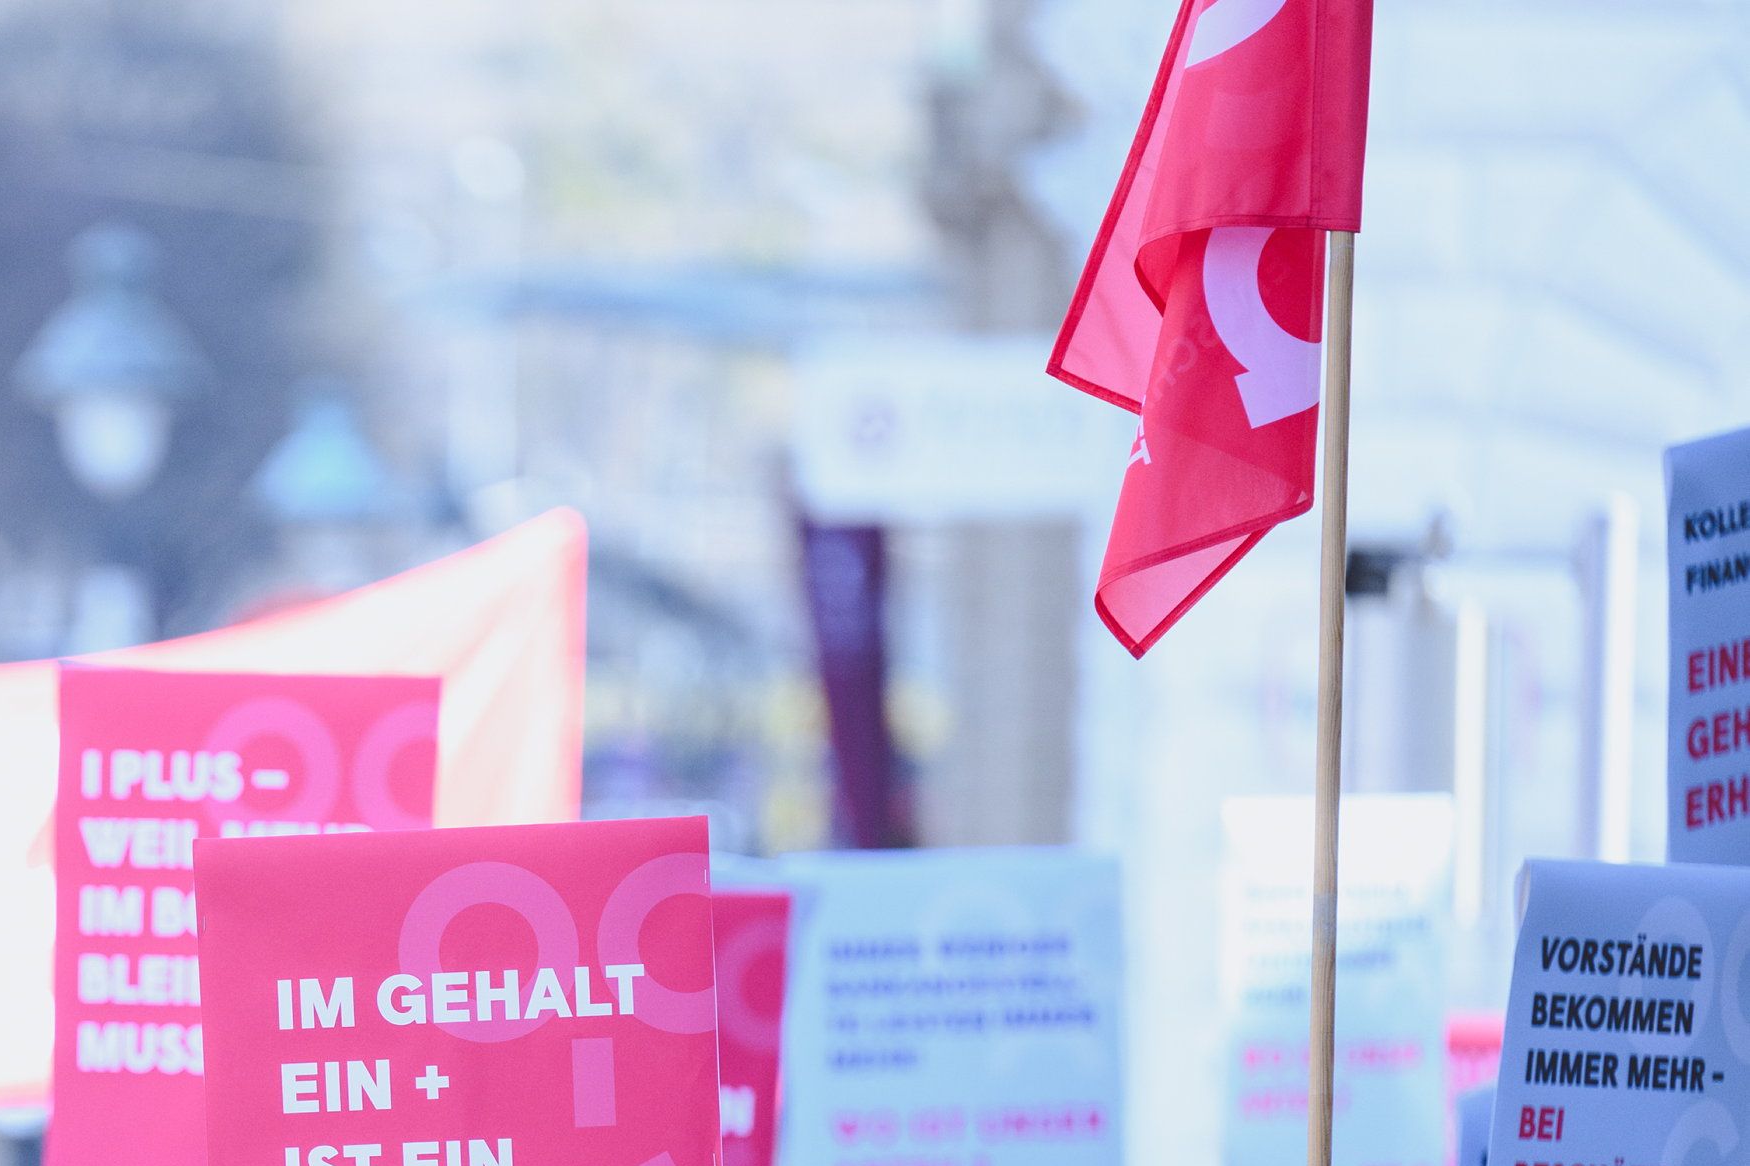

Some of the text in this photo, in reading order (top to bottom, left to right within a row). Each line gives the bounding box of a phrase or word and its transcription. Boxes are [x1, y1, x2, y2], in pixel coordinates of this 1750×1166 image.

[110, 750, 245, 801] PLUS
[79, 885, 145, 936] IM
[1540, 933, 1703, 980] VORSTÄNDE
[277, 963, 647, 1030] IM GEHALT
[1531, 992, 1695, 1035] BEKOMMEN
[281, 1058, 450, 1114] EIN +
[1524, 1048, 1619, 1089] IMMER
[1626, 1054, 1706, 1092] MEHR
[1517, 1105, 1565, 1141] BEI
